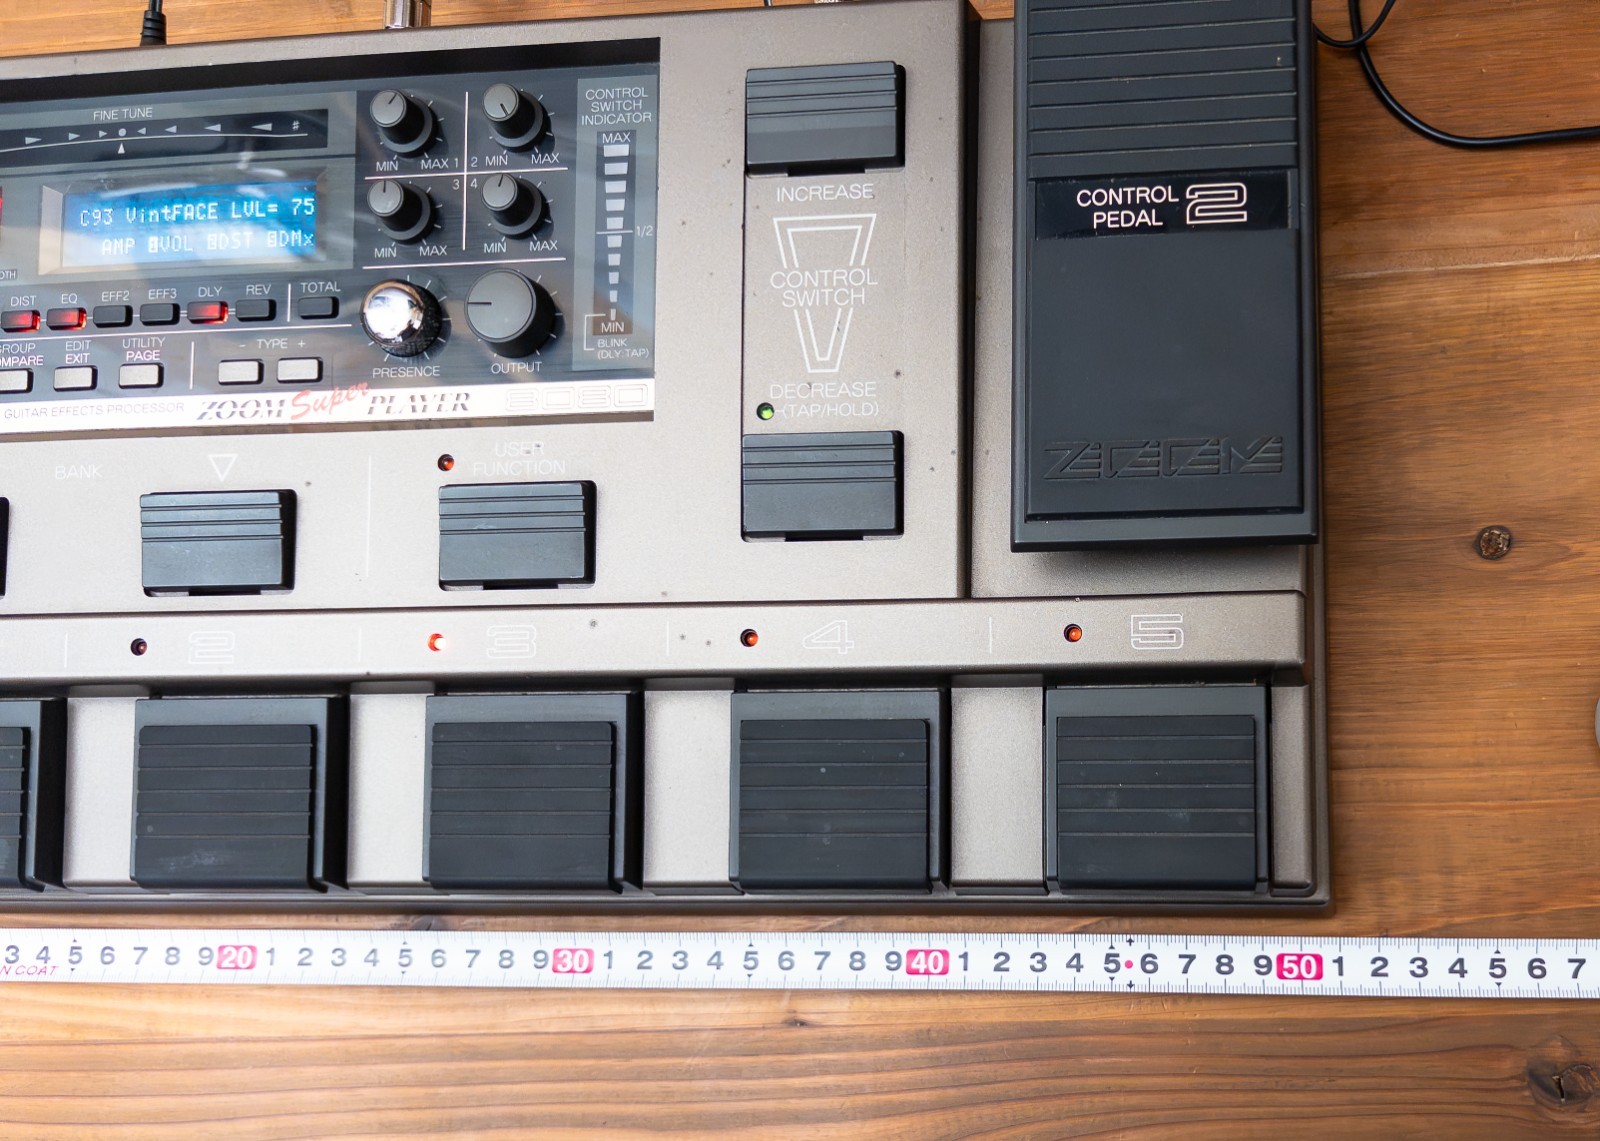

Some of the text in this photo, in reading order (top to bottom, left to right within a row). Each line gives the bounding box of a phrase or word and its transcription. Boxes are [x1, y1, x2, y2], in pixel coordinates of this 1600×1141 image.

[585, 87, 648, 100] CONTROL
[591, 99, 642, 112] SWITCH
[93, 106, 153, 121] FINE TUNE
[581, 112, 652, 126] INDICATOR
[602, 132, 631, 144] MAX
[376, 158, 449, 172] MIN MAX
[453, 158, 459, 168] 1
[471, 157, 478, 168] 2
[485, 152, 560, 166] MIN MAX
[452, 179, 460, 189] 3
[470, 178, 478, 189] 4
[776, 183, 874, 202] INCREASE
[1076, 185, 1179, 207] CONTROL
[1186, 182, 1247, 225] 2
[80, 208, 113, 227] C93
[291, 198, 315, 216] 75
[1093, 209, 1163, 229] PEDAL
[636, 225, 653, 237] 1/2
[101, 238, 136, 256] AMP
[374, 245, 447, 259] MIN MAX
[483, 240, 558, 254] MIN MAX
[770, 268, 878, 289] CONTROL
[148, 288, 177, 300] EFF3
[198, 286, 223, 298] DLY
[246, 284, 272, 296] REV
[300, 281, 341, 294] TOTAL
[10, 295, 37, 308] DIST
[61, 293, 78, 305] EQ
[101, 290, 130, 303] EFF2
[782, 288, 865, 308] SWITCH
[601, 321, 625, 333] MIN
[0, 342, 36, 354] ROUP
[65, 339, 92, 352] EDIT
[122, 337, 166, 349] UTILITY
[256, 337, 289, 350] TYPE
[597, 338, 628, 348] BLINK
[0, 354, 44, 368] MPARE
[65, 353, 91, 365] EXIT
[126, 349, 161, 362] PAGE
[372, 365, 441, 378] PRESENCE
[491, 361, 543, 374] OUTPUT
[769, 381, 877, 400] DECREASE
[196, 382, 649, 421] ZOOM Super PLAYER 8080
[4, 401, 185, 420] GUITAR EFFECTS PROCESSOR
[783, 402, 880, 419] (TAP/HOLD)
[494, 440, 544, 458] USER
[54, 464, 103, 480] BANK
[472, 458, 566, 479] FUNCTION
[802, 619, 855, 655] 4
[1130, 614, 1185, 651] 5
[188, 630, 236, 665] 2
[486, 624, 538, 659] 3
[5, 945, 1586, 979] 3 4 5 6 7 8 9 20 1 2 3 4 5 6 7 8 9 30 1 2 3 4 5 6 7 8 9 40 1 2 3 4 5 6 7 8 9 50 1 2 3 4 5 6 7
[15, 964, 59, 976] COAT
